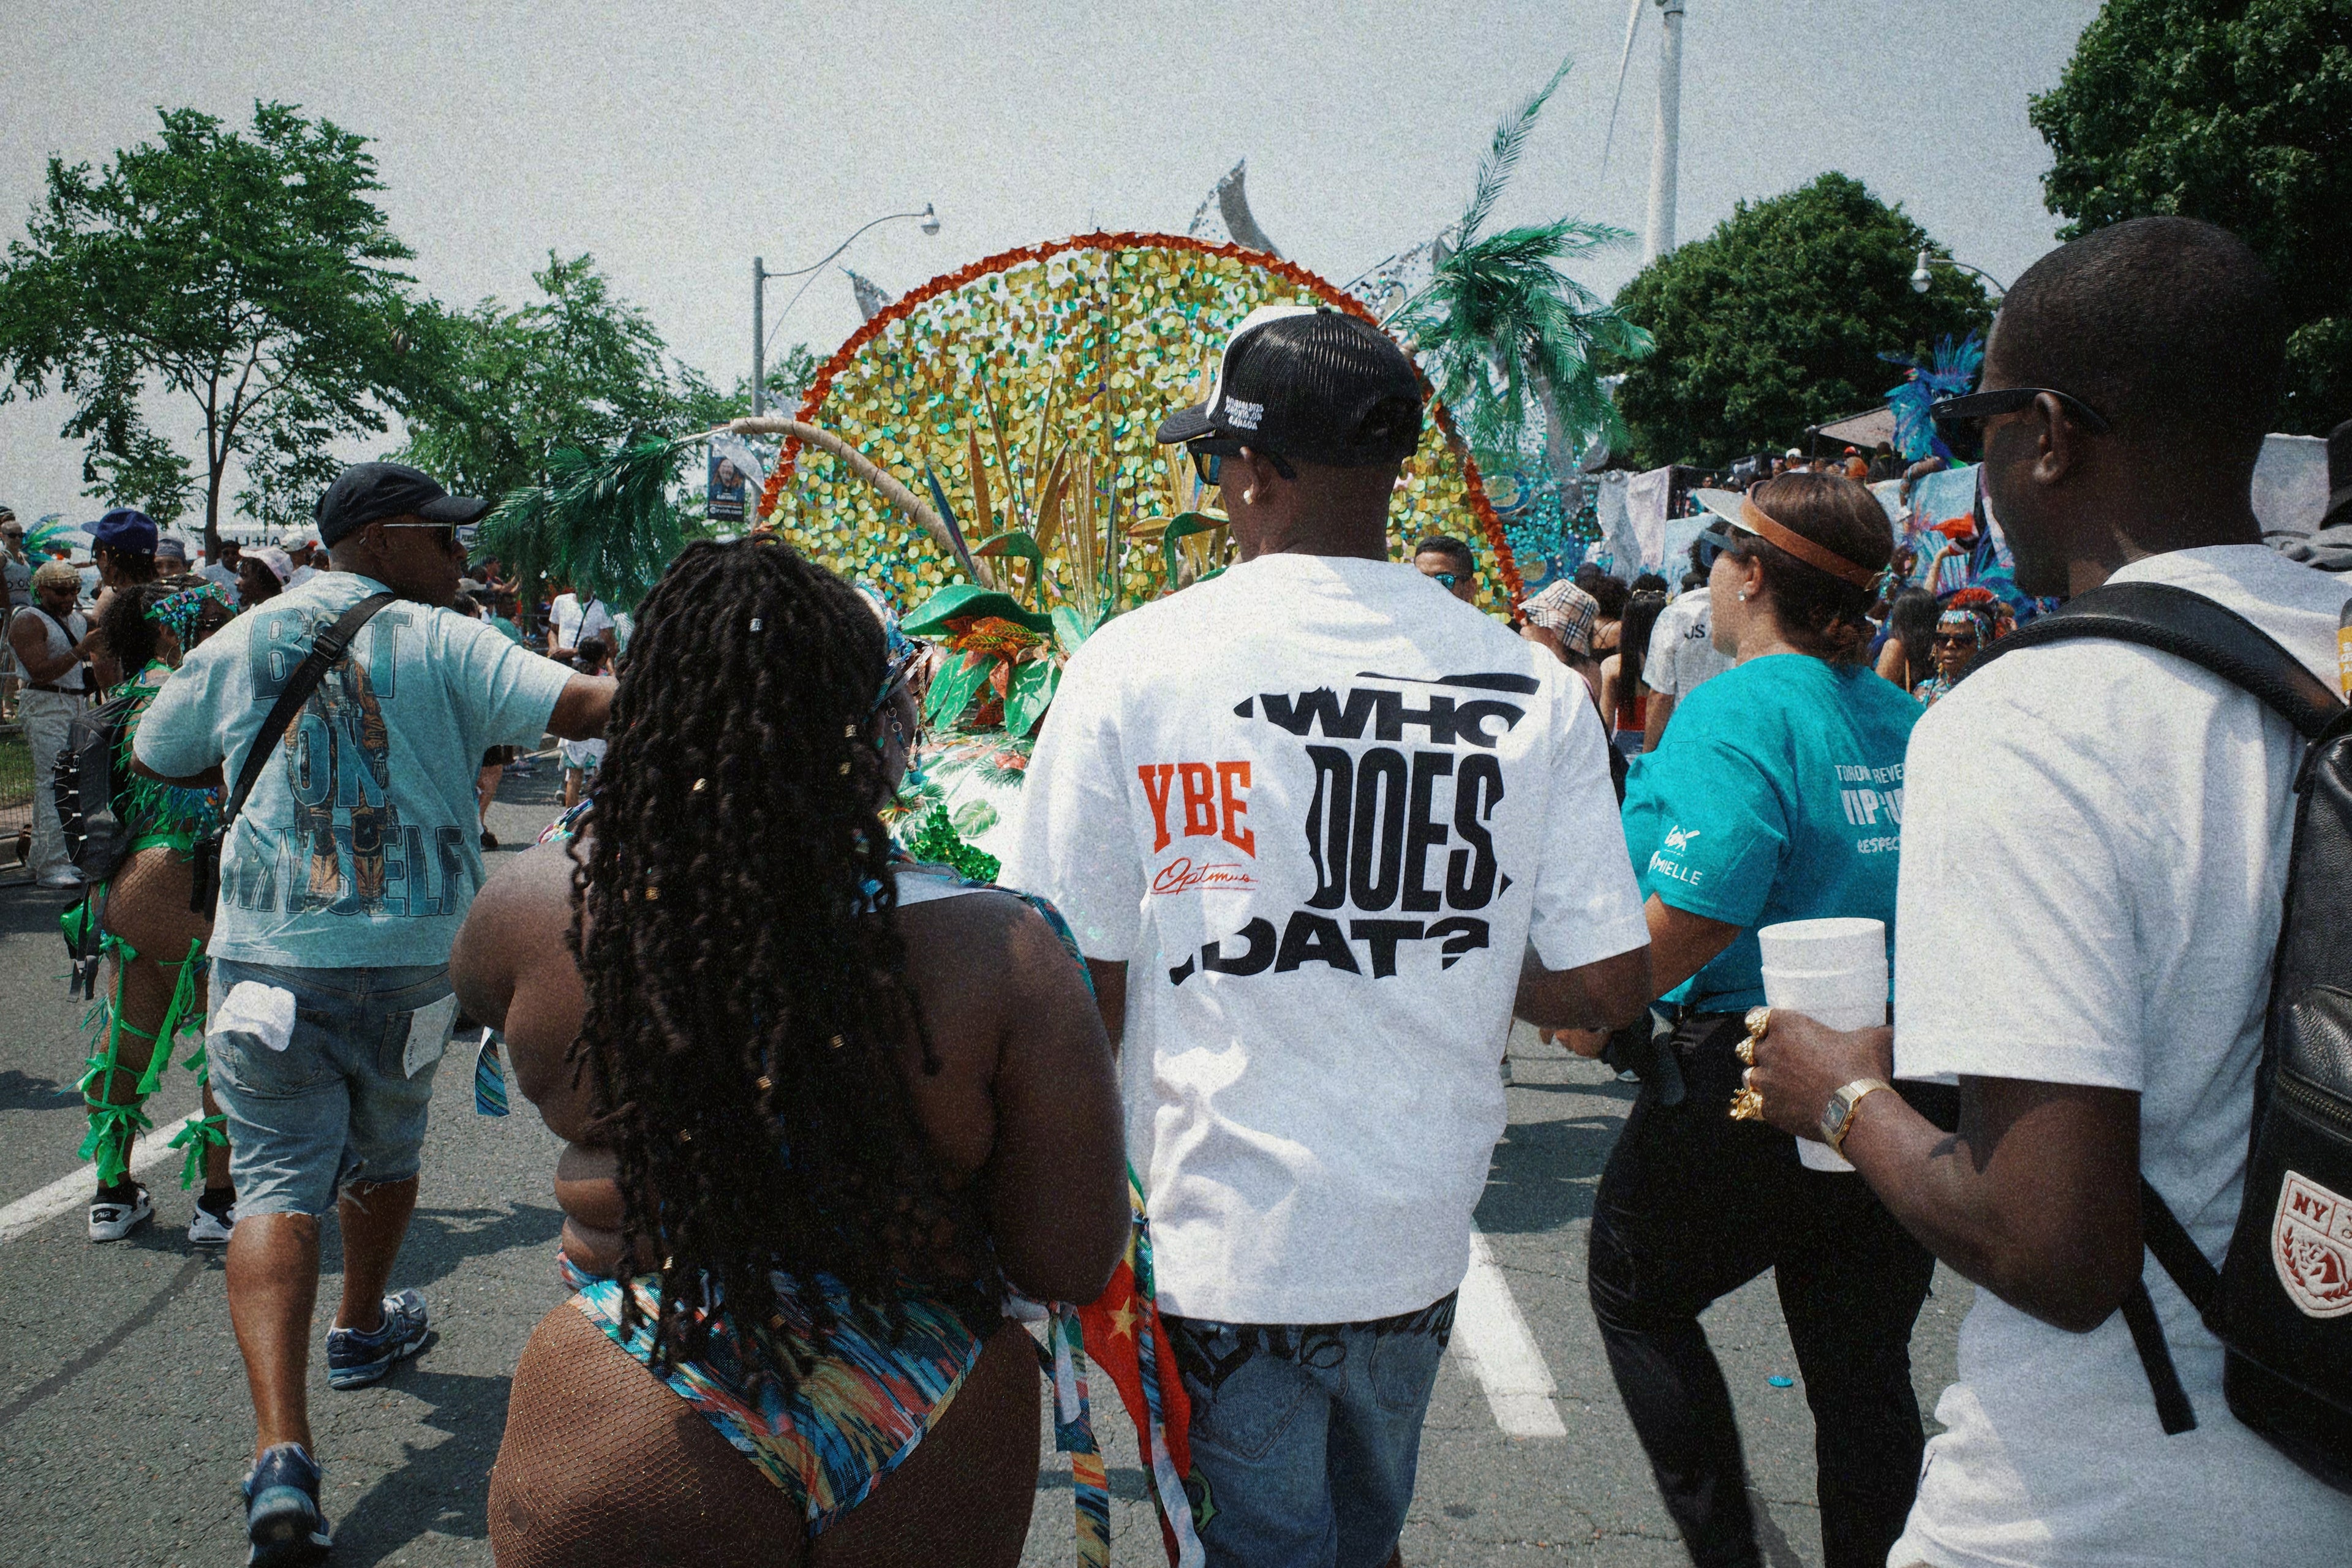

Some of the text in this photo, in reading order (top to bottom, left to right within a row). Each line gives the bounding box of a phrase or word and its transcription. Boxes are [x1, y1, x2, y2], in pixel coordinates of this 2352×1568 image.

[1228, 415, 1258, 430] CANADA
[235, 535, 282, 546] U-HA
[1234, 685, 1526, 748] WHO
[290, 713, 385, 807] ON
[1872, 763, 1904, 784] REVE
[1137, 761, 1256, 859] YBE
[1303, 745, 1505, 912] DOES
[1857, 836, 1900, 854] RESPEC
[1169, 910, 1490, 986] DAT?
[2293, 1191, 2329, 1223] NY
